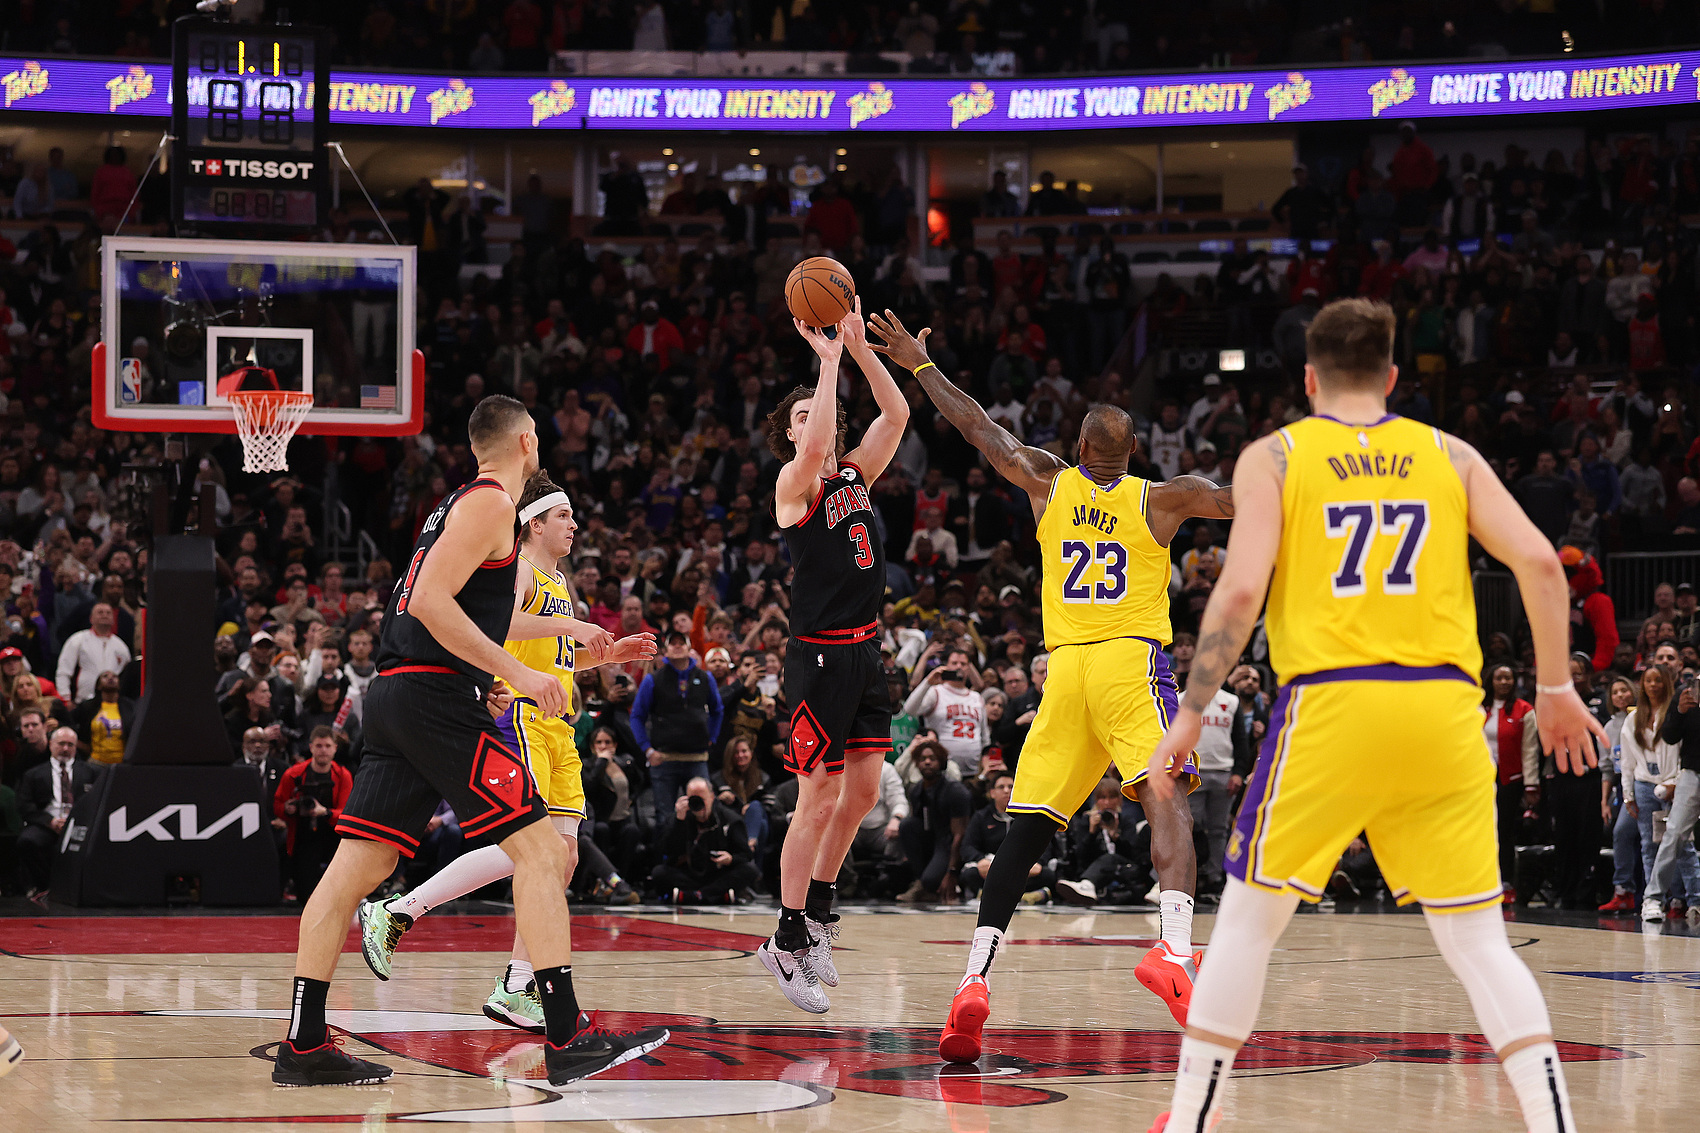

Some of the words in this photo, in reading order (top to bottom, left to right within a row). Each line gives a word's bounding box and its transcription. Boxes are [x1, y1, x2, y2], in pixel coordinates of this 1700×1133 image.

[238, 41, 280, 77] 1.1
[1008, 88, 1081, 119] IGNITE
[1084, 86, 1141, 117] YOUR
[1142, 83, 1255, 115] INTENSITY
[1429, 72, 1504, 105] IGNITE
[1507, 70, 1568, 101] YOUR
[1570, 62, 1682, 98] INTENSITY
[588, 88, 661, 118] IGNITE
[664, 88, 722, 118] YOUR
[723, 89, 836, 119] INTENSITY
[224, 159, 314, 180] TISSOT
[1327, 449, 1415, 481] DONČIĆ
[1072, 504, 1118, 535] JAMES
[848, 522, 875, 570] 3
[1323, 499, 1431, 598] 77
[1061, 539, 1129, 605] 23
[554, 634, 575, 673] 15
[953, 719, 975, 739] 23
[108, 802, 260, 842] KIA
